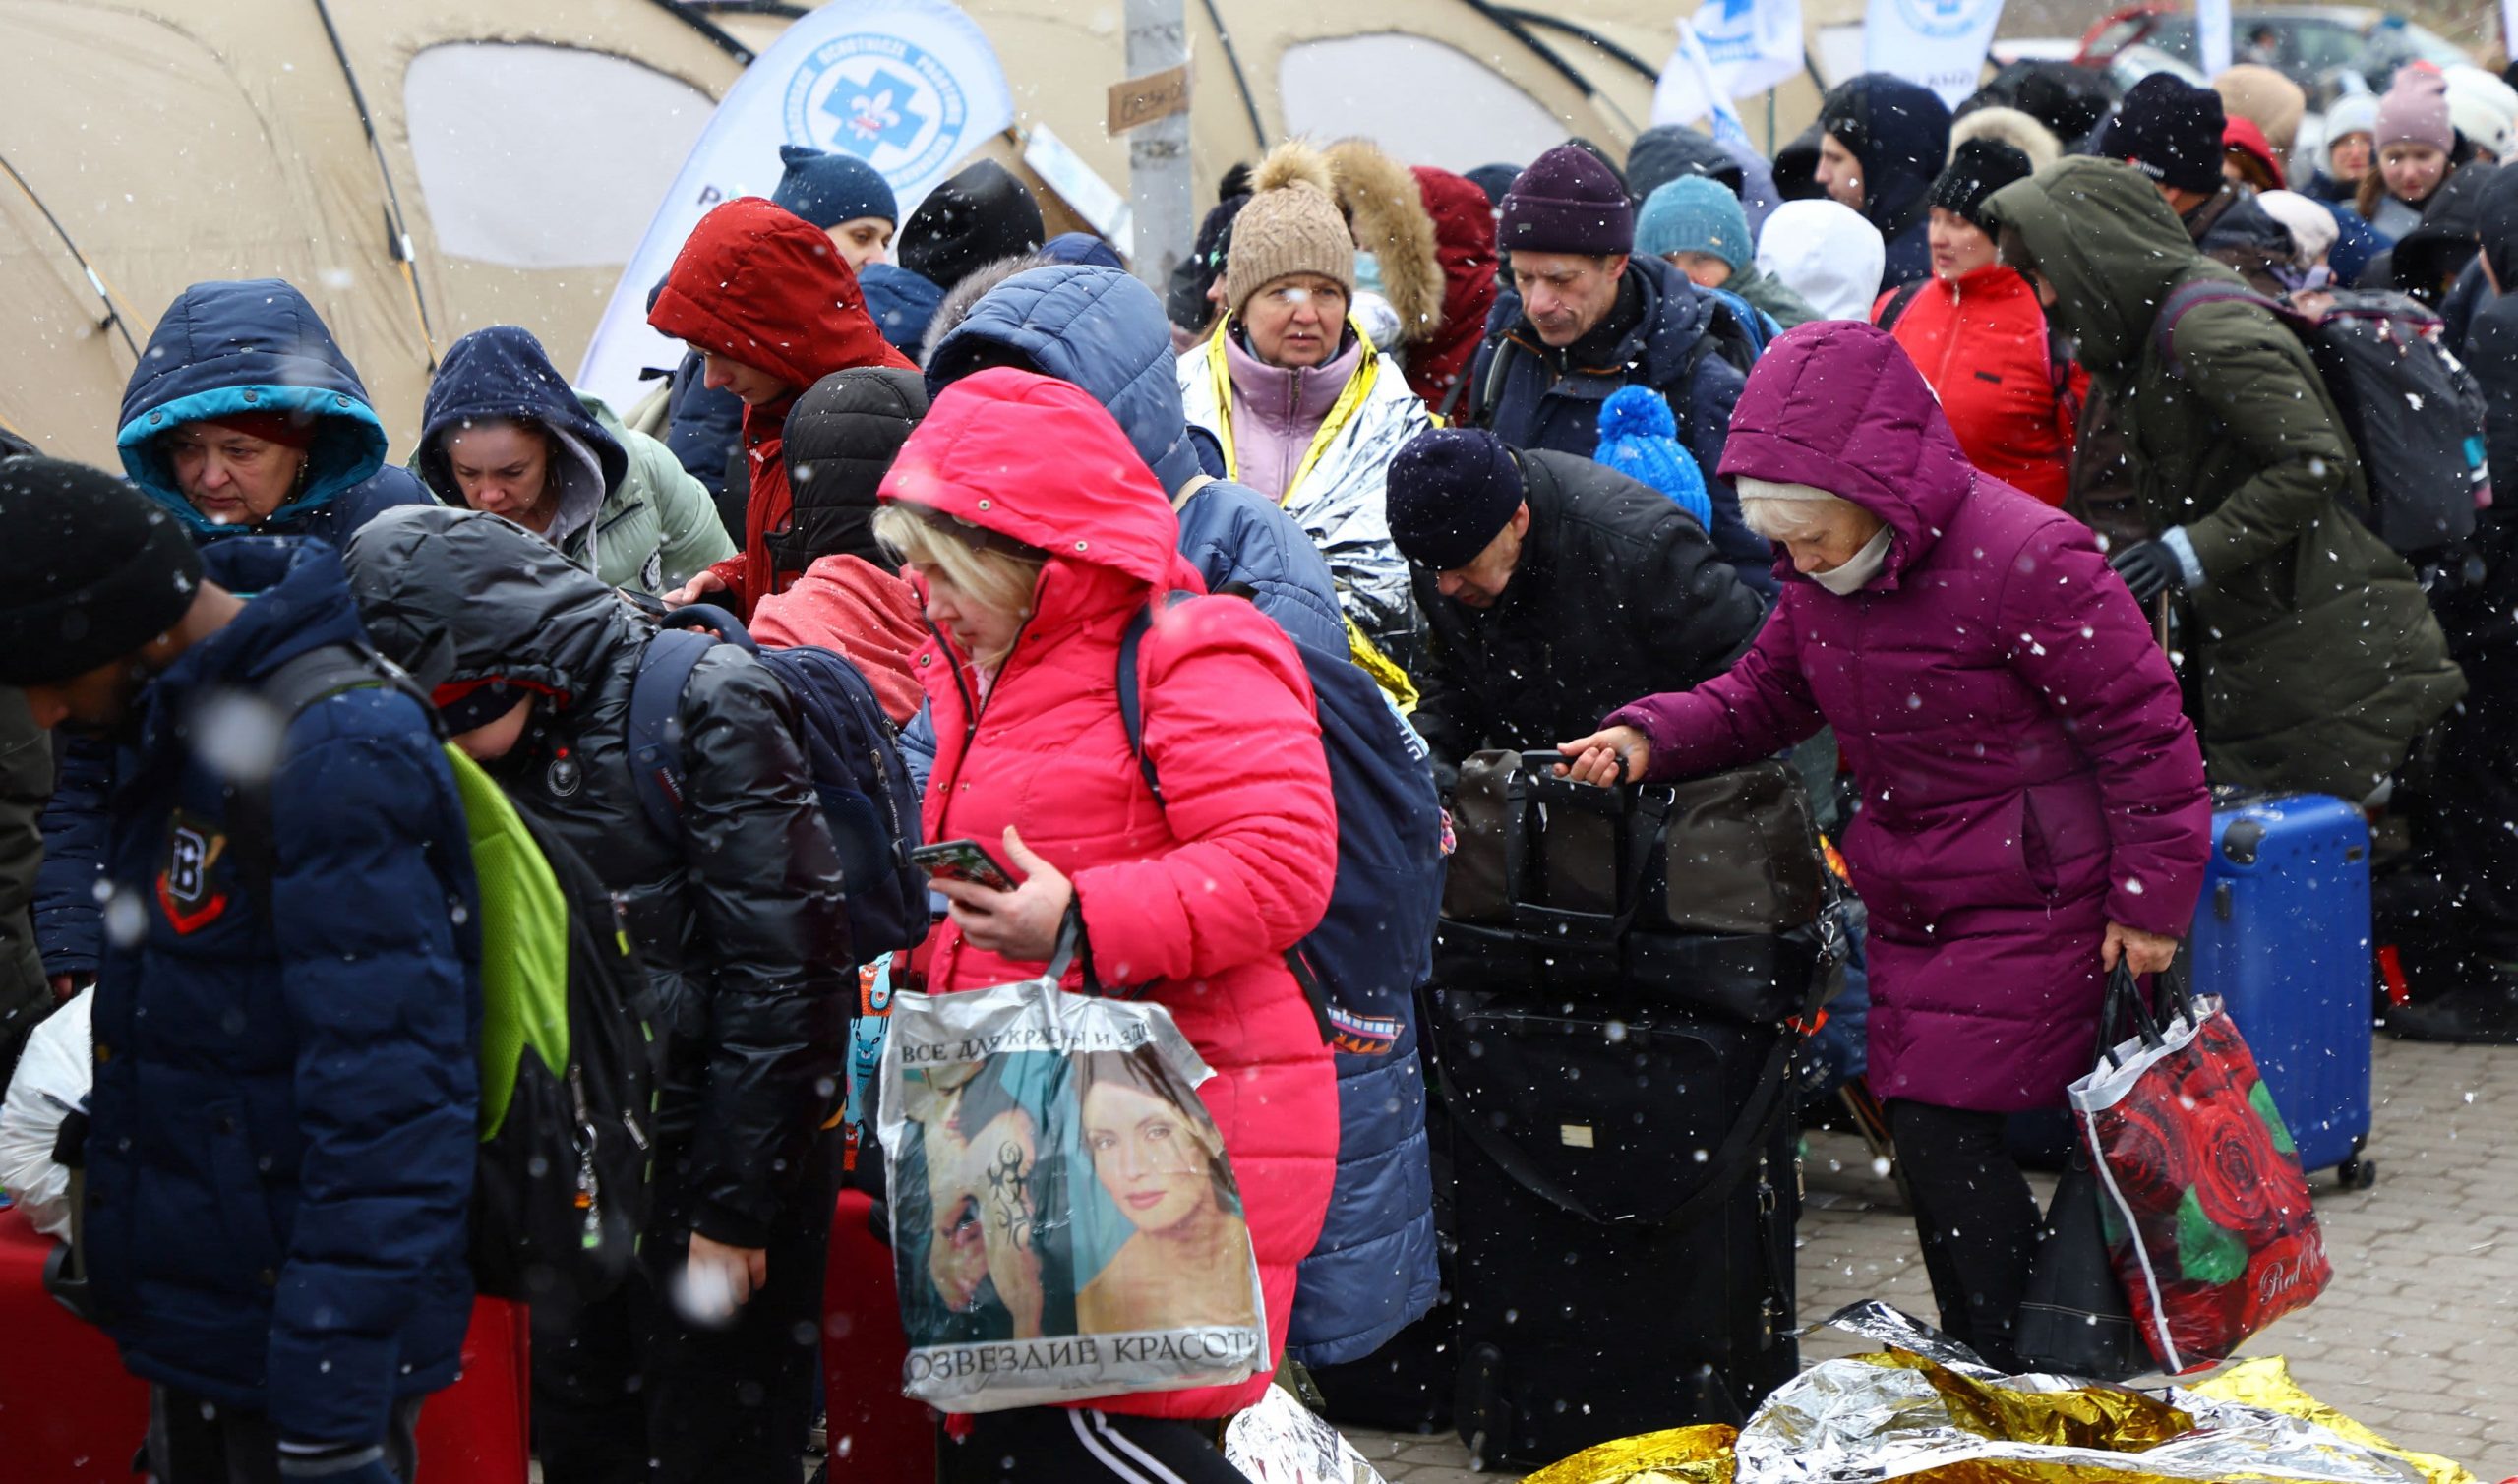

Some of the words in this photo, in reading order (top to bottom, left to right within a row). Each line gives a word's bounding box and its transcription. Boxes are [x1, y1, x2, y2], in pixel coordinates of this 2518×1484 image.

[902, 1043, 948, 1064] ВСЕ
[957, 1034, 1001, 1060] ДЛЯ
[1094, 1032, 1110, 1046] И
[904, 1338, 1099, 1382] ОЗВЕЗДИЕ
